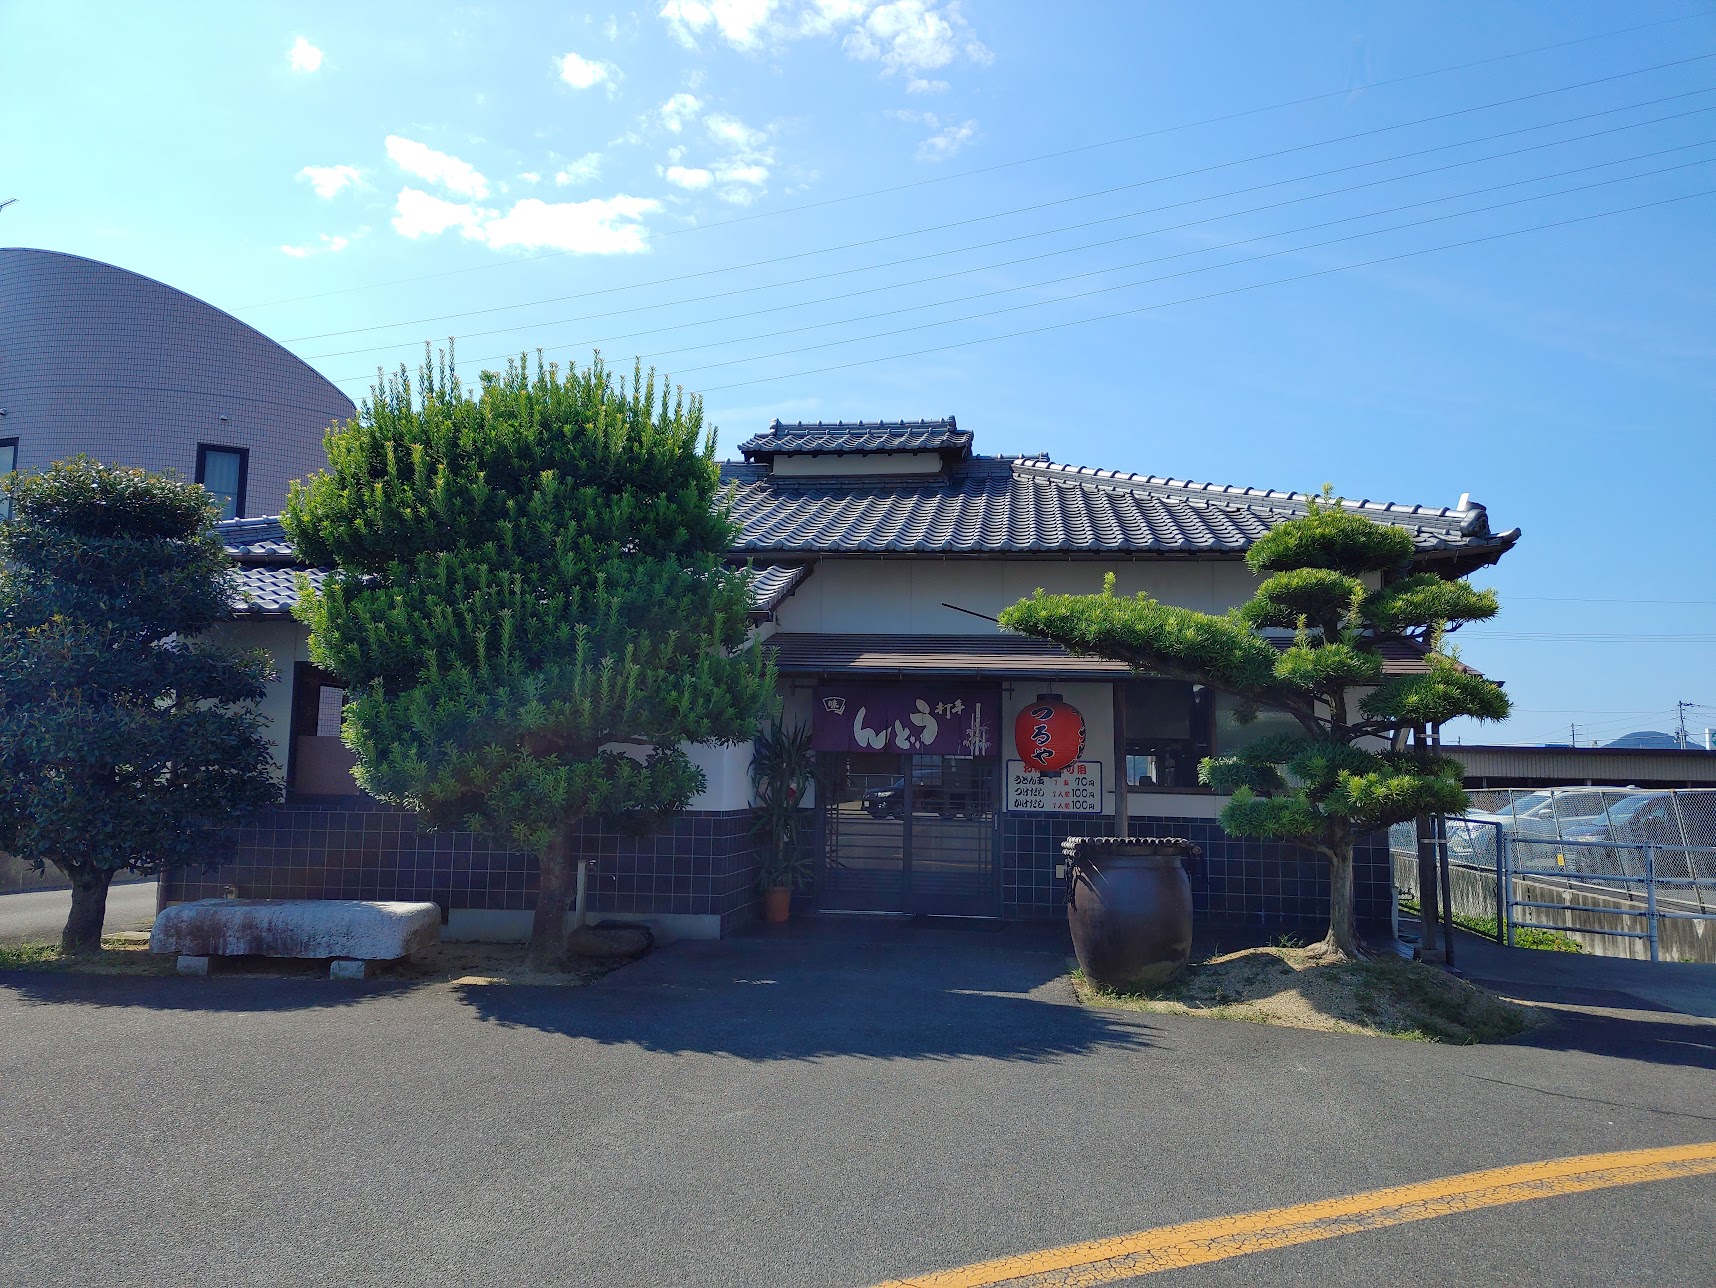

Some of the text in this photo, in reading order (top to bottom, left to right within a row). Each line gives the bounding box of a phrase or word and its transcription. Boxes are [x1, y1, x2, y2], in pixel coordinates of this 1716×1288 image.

[1030, 706, 1055, 765] つるや
[1014, 787, 1045, 797] つけだし
[1014, 799, 1045, 809] かけだし
